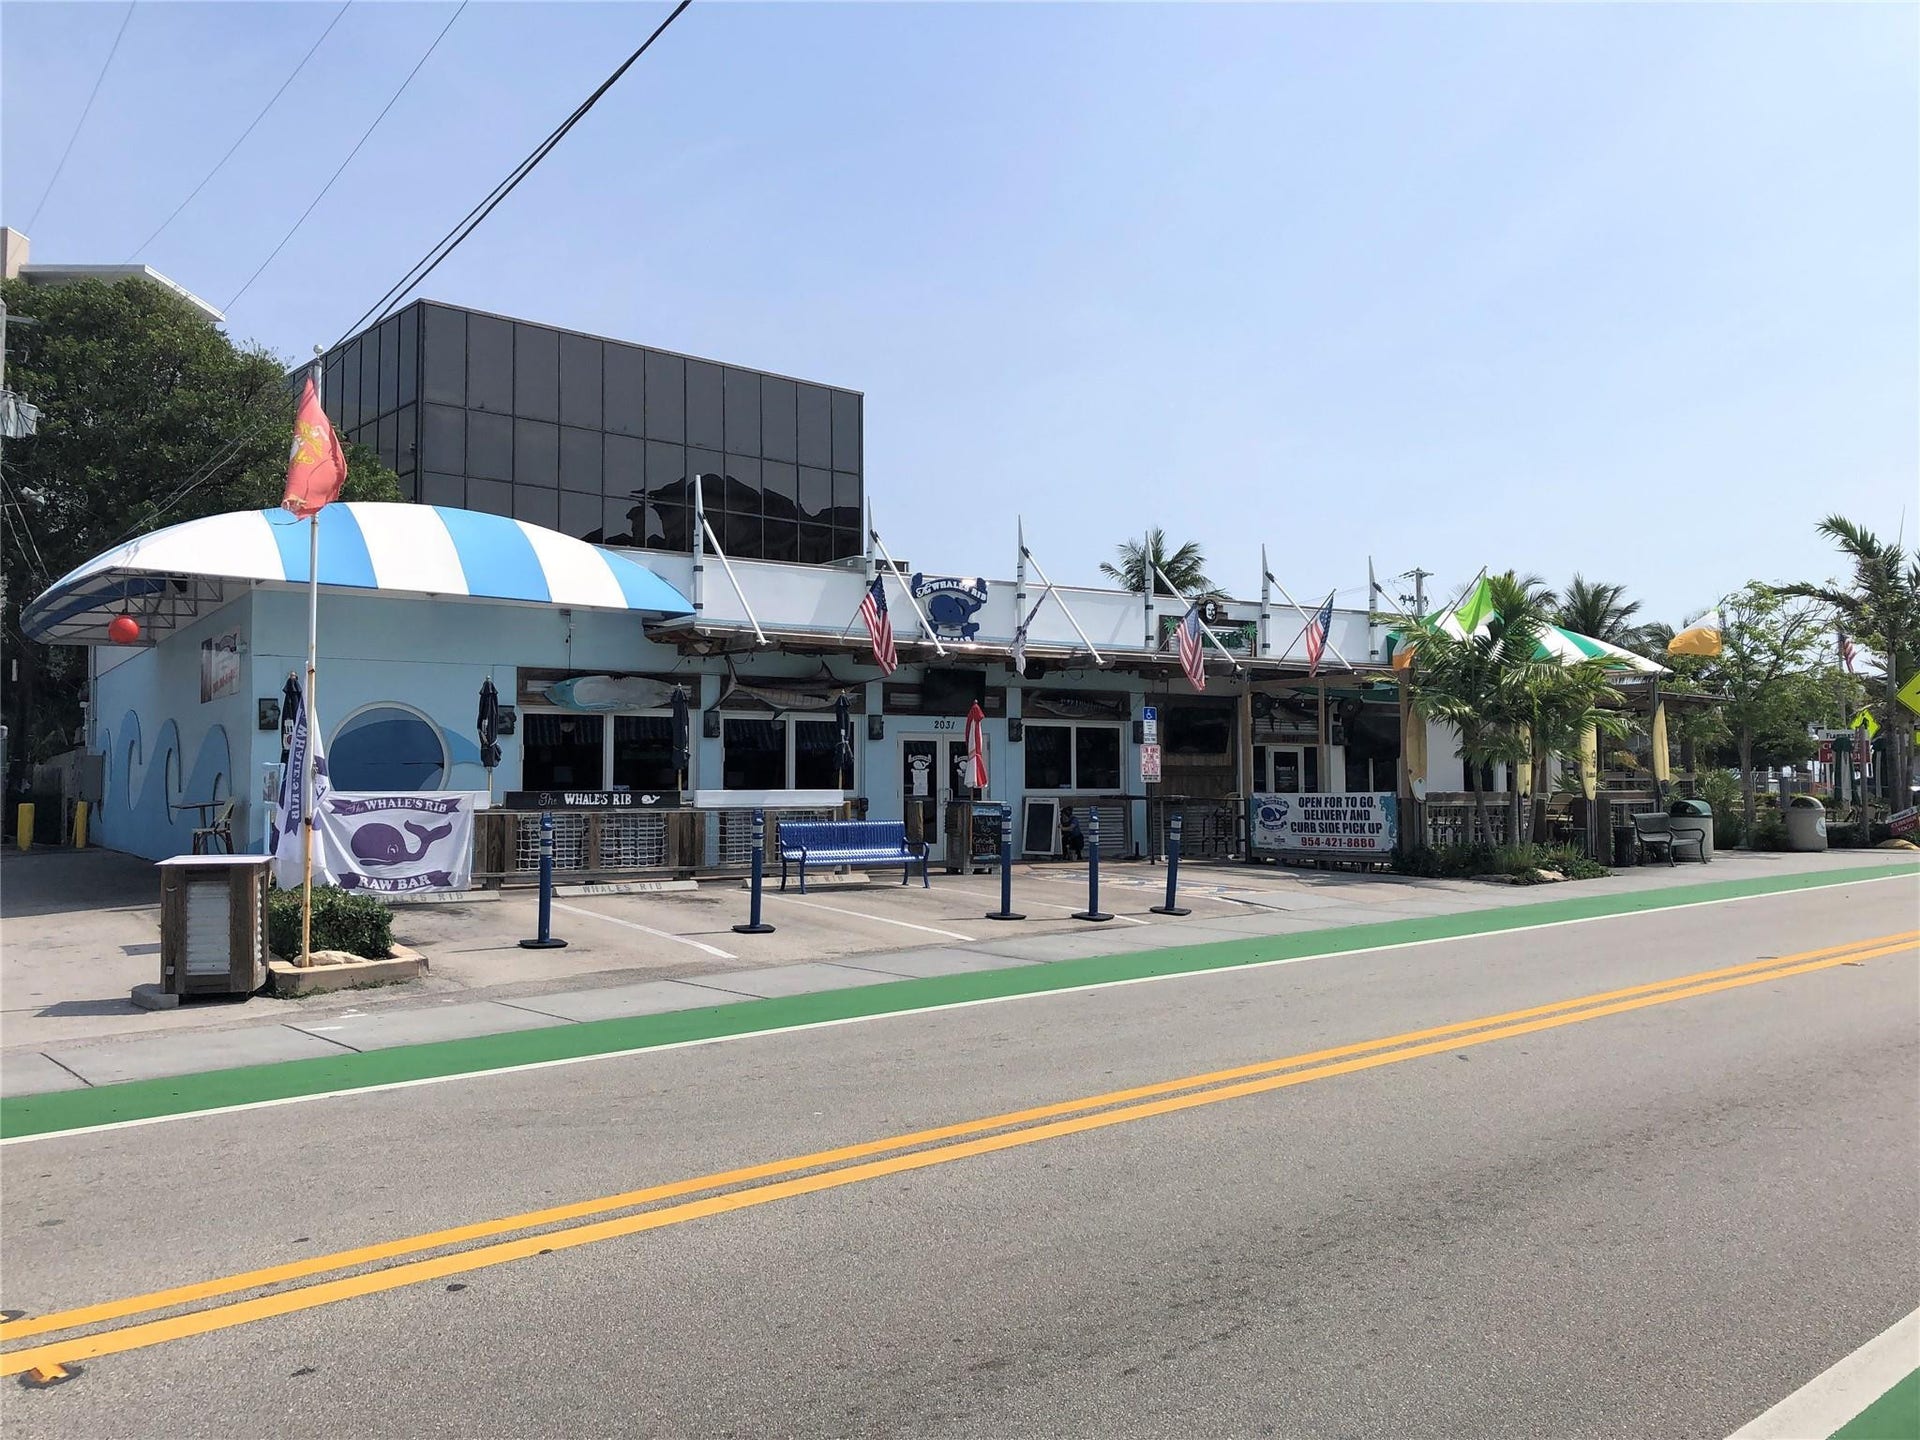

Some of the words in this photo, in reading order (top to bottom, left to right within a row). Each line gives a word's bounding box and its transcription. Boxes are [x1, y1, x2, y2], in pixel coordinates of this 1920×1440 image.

[971, 588, 986, 600] RIB
[934, 720, 956, 730] 2031
[365, 798, 423, 811] WHALE'S
[425, 801, 447, 813] RIB
[564, 793, 609, 806] WHALE'S
[613, 793, 632, 806] RIB
[1298, 796, 1322, 808] OPEN
[1324, 796, 1342, 808] FOR
[1345, 796, 1358, 808] TO
[1304, 809, 1349, 821] DELIVERY
[1350, 810, 1370, 821] AND
[1290, 822, 1317, 834] CURB
[1318, 822, 1340, 834] SIDE
[1342, 822, 1366, 835] PICK
[1368, 822, 1383, 835] UP
[358, 875, 394, 890] RAW
[397, 874, 431, 890] BAR
